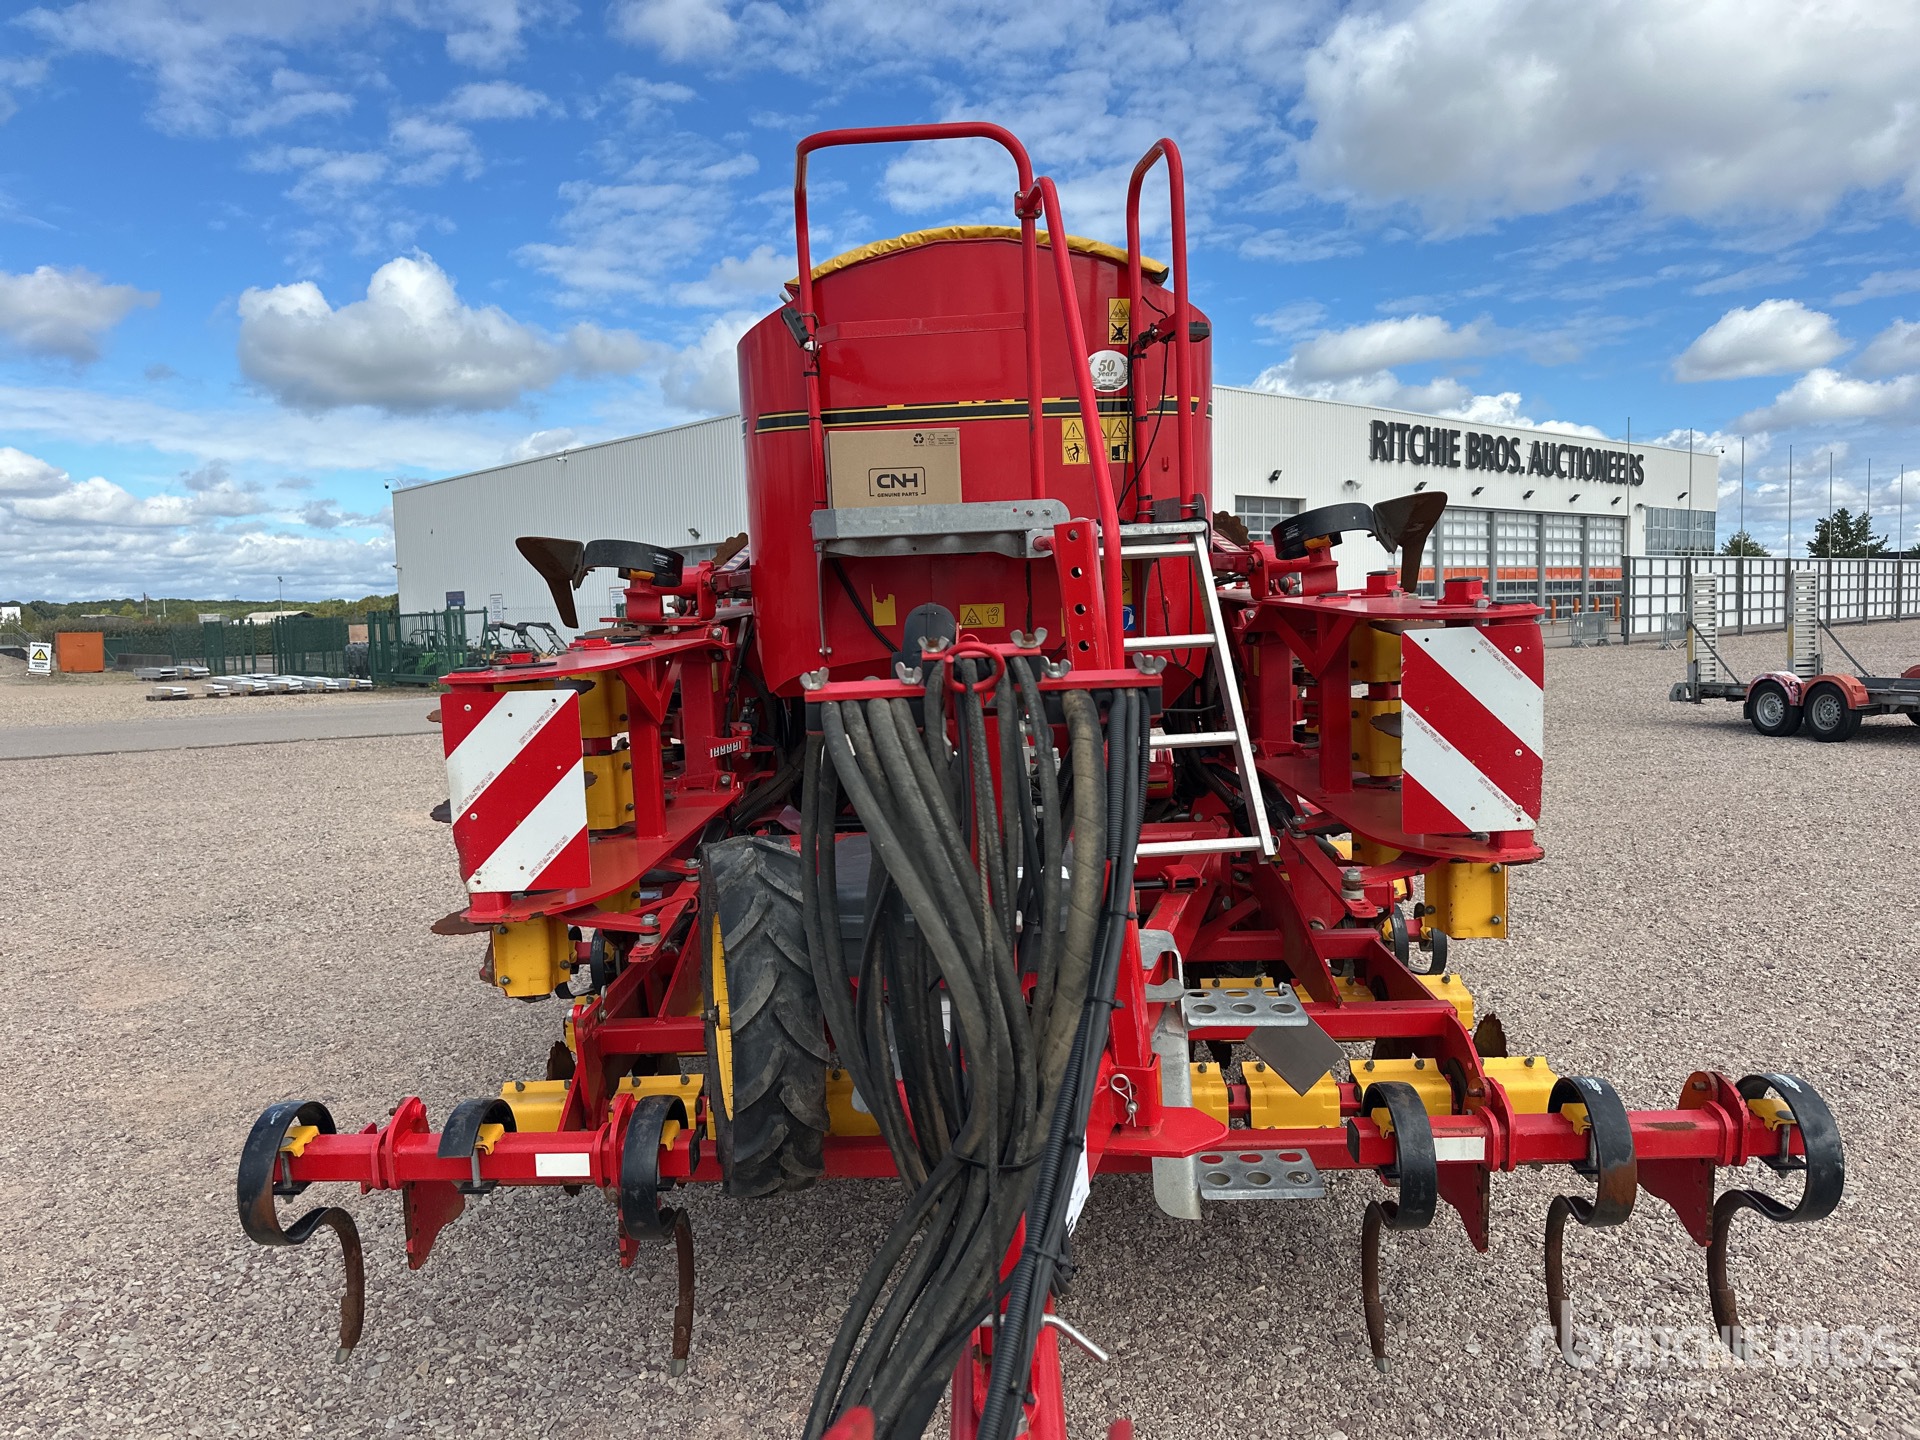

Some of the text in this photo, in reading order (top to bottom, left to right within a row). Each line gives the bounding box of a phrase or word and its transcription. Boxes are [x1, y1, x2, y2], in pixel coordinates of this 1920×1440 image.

[1098, 359, 1116, 372] 50
[1097, 371, 1118, 379] years
[1369, 420, 1645, 486] RITCHIE BROS. AUCTIONEERS
[876, 473, 918, 488] CNH
